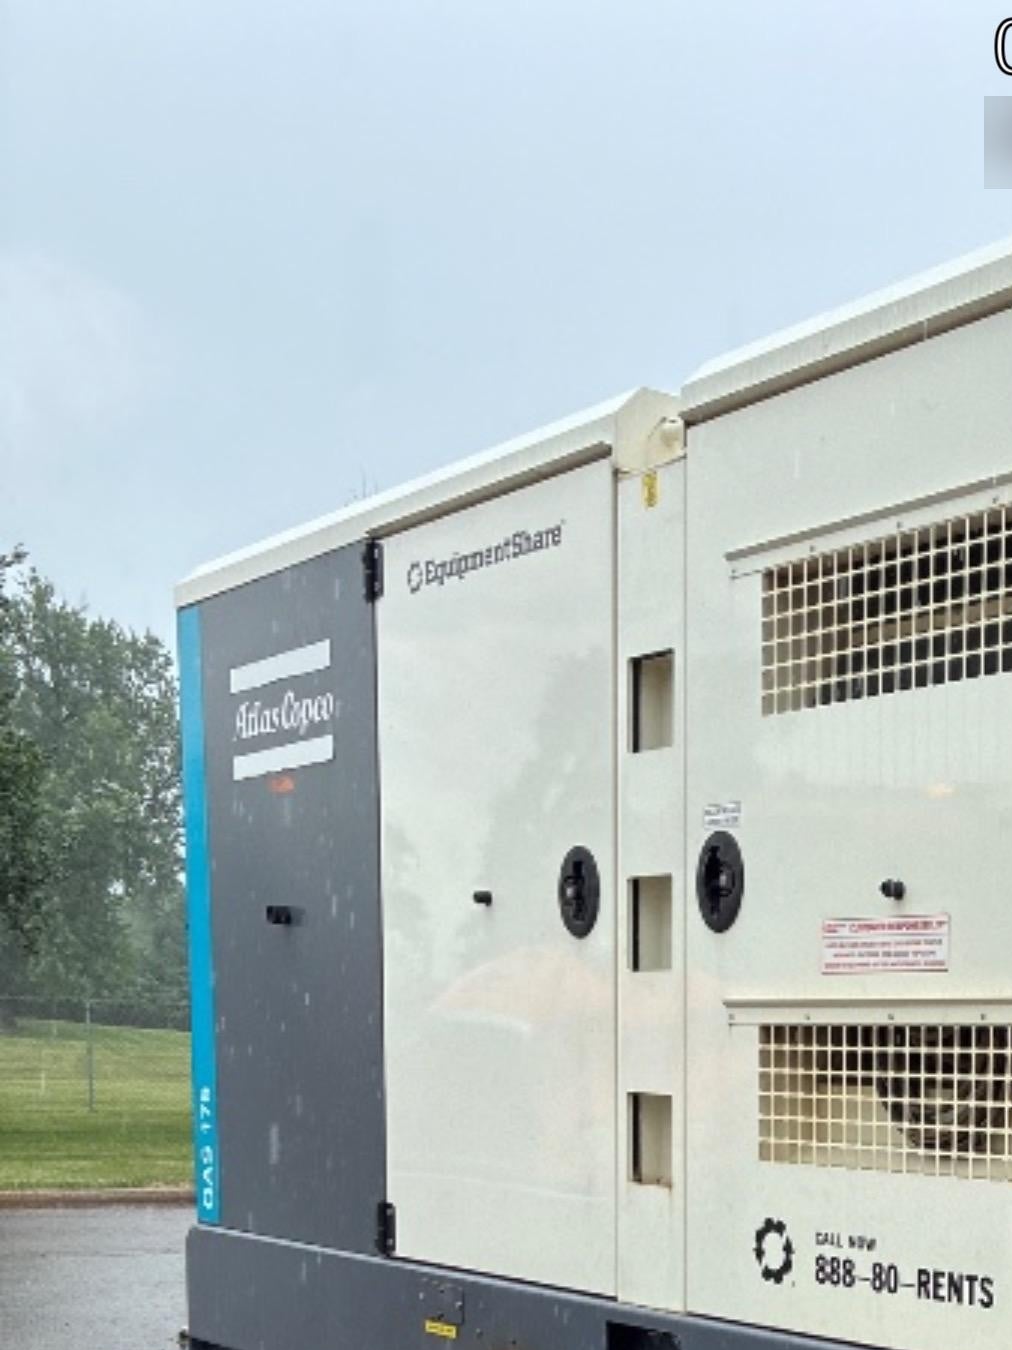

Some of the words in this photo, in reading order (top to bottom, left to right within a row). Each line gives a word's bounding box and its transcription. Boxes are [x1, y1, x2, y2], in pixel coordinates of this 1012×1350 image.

[425, 525, 561, 587] EquipmentShare
[232, 701, 280, 742] Atlas
[280, 690, 334, 736] Copco
[815, 1231, 844, 1249] CALL
[848, 1234, 877, 1252] NOW
[814, 1253, 994, 1309] 888-80-RENTS
